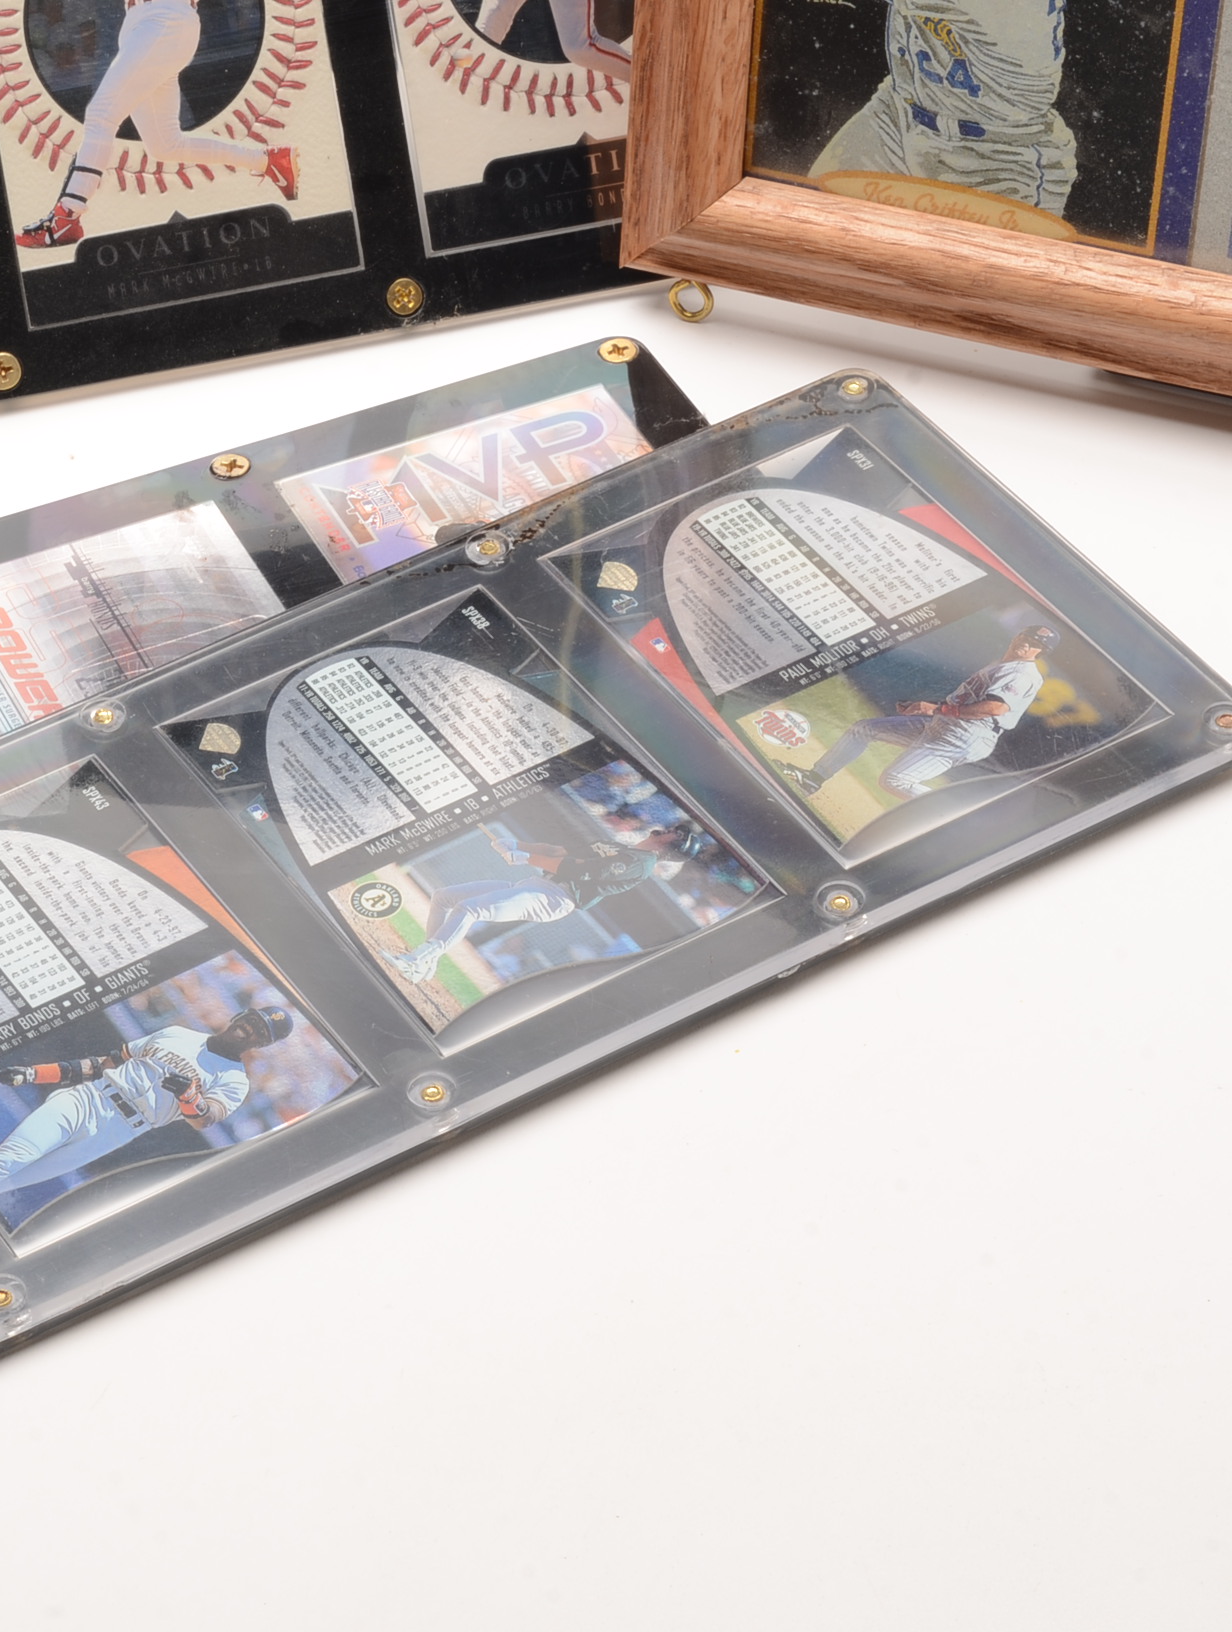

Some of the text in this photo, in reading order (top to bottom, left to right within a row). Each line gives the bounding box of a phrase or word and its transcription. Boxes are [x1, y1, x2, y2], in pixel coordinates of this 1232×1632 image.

[96, 216, 270, 267] OVATION
[107, 279, 151, 299] MARK
[313, 408, 609, 547] MVP
[845, 449, 875, 470] SPX31
[460, 605, 491, 630] SPX38
[777, 661, 813, 682] PAUL
[808, 639, 861, 668] MOLITOR
[755, 711, 806, 747] Twins
[80, 785, 111, 811] SPX43
[363, 833, 402, 856] MARK
[397, 809, 453, 840] McGWIRE
[16, 1002, 62, 1030] BONDS
[71, 988, 93, 1004] OF
